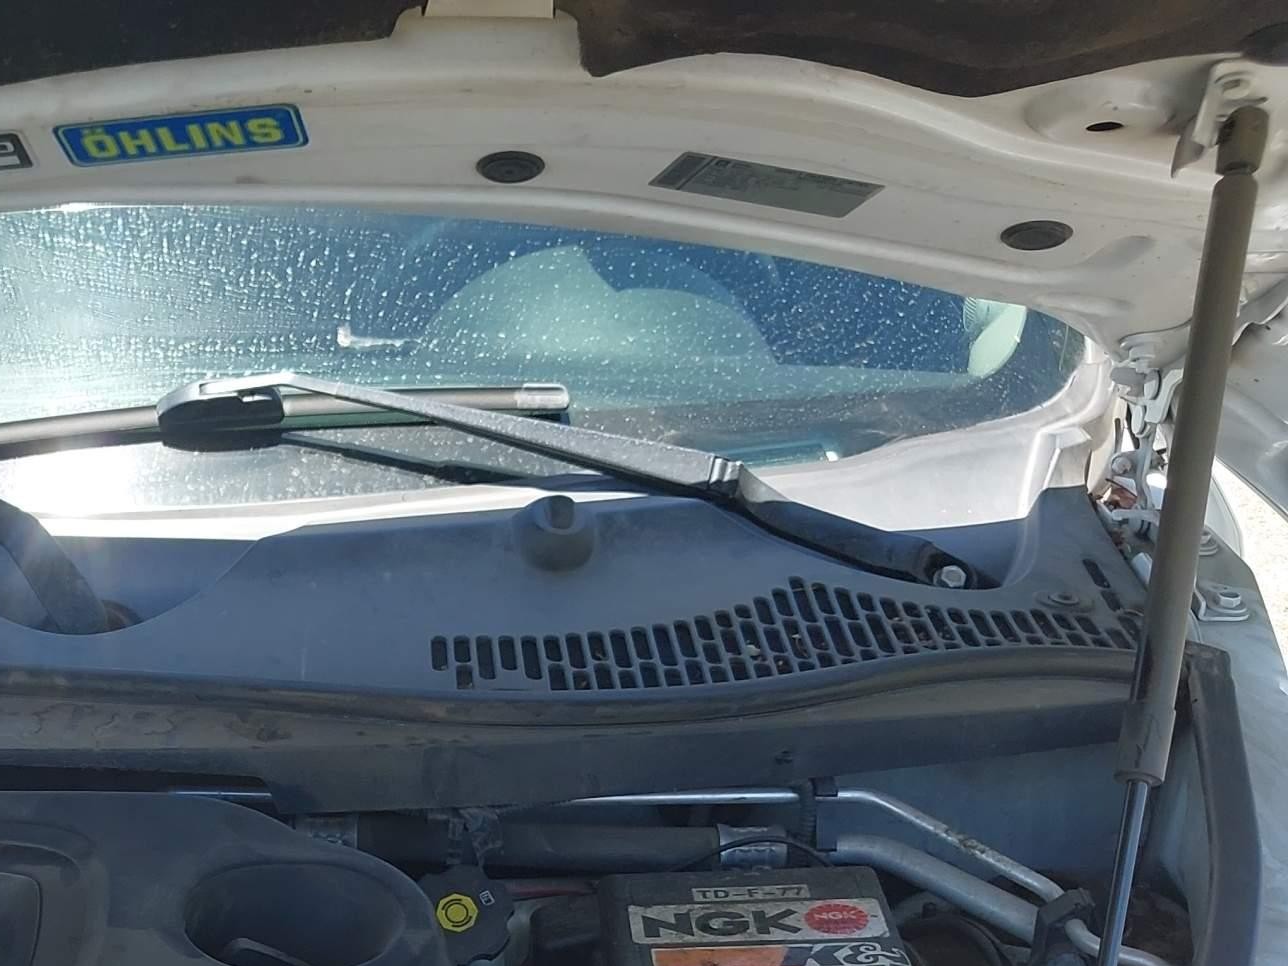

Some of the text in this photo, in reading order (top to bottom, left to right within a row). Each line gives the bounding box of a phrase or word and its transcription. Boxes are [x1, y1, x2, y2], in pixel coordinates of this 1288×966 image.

[81, 117, 284, 159] ÖHLINS
[641, 908, 802, 938] NGK
[813, 911, 857, 920] NGK
